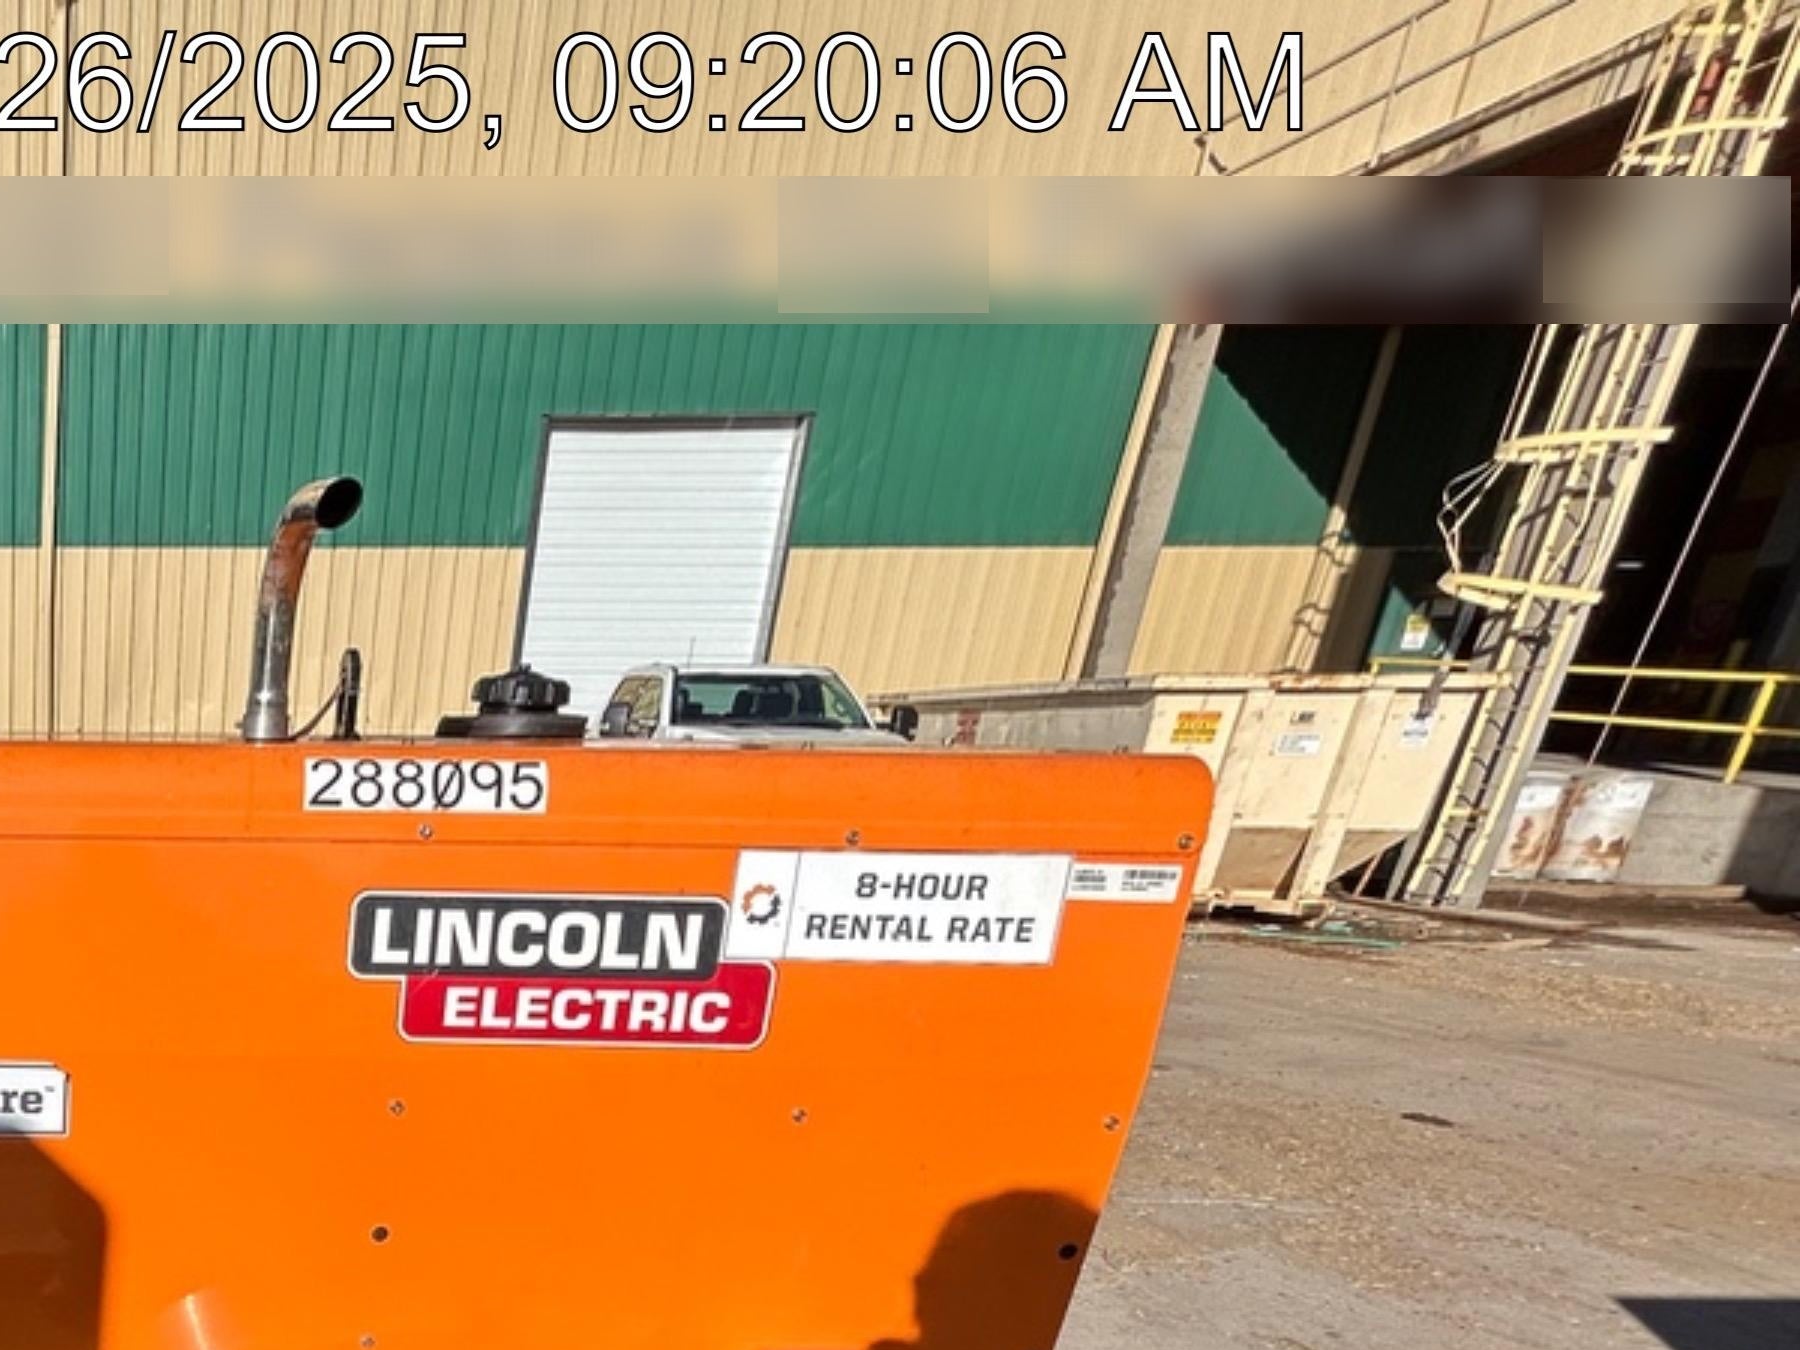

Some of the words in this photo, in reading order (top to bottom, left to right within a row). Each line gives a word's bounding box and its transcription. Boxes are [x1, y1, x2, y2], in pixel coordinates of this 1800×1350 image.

[307, 758, 545, 810] 288095
[855, 873, 989, 900] 8-HOUR
[371, 912, 702, 969] LINCOLN
[805, 914, 939, 940] RENTAL
[953, 916, 1036, 943] RATE
[442, 986, 730, 1033] ELECTRIC
